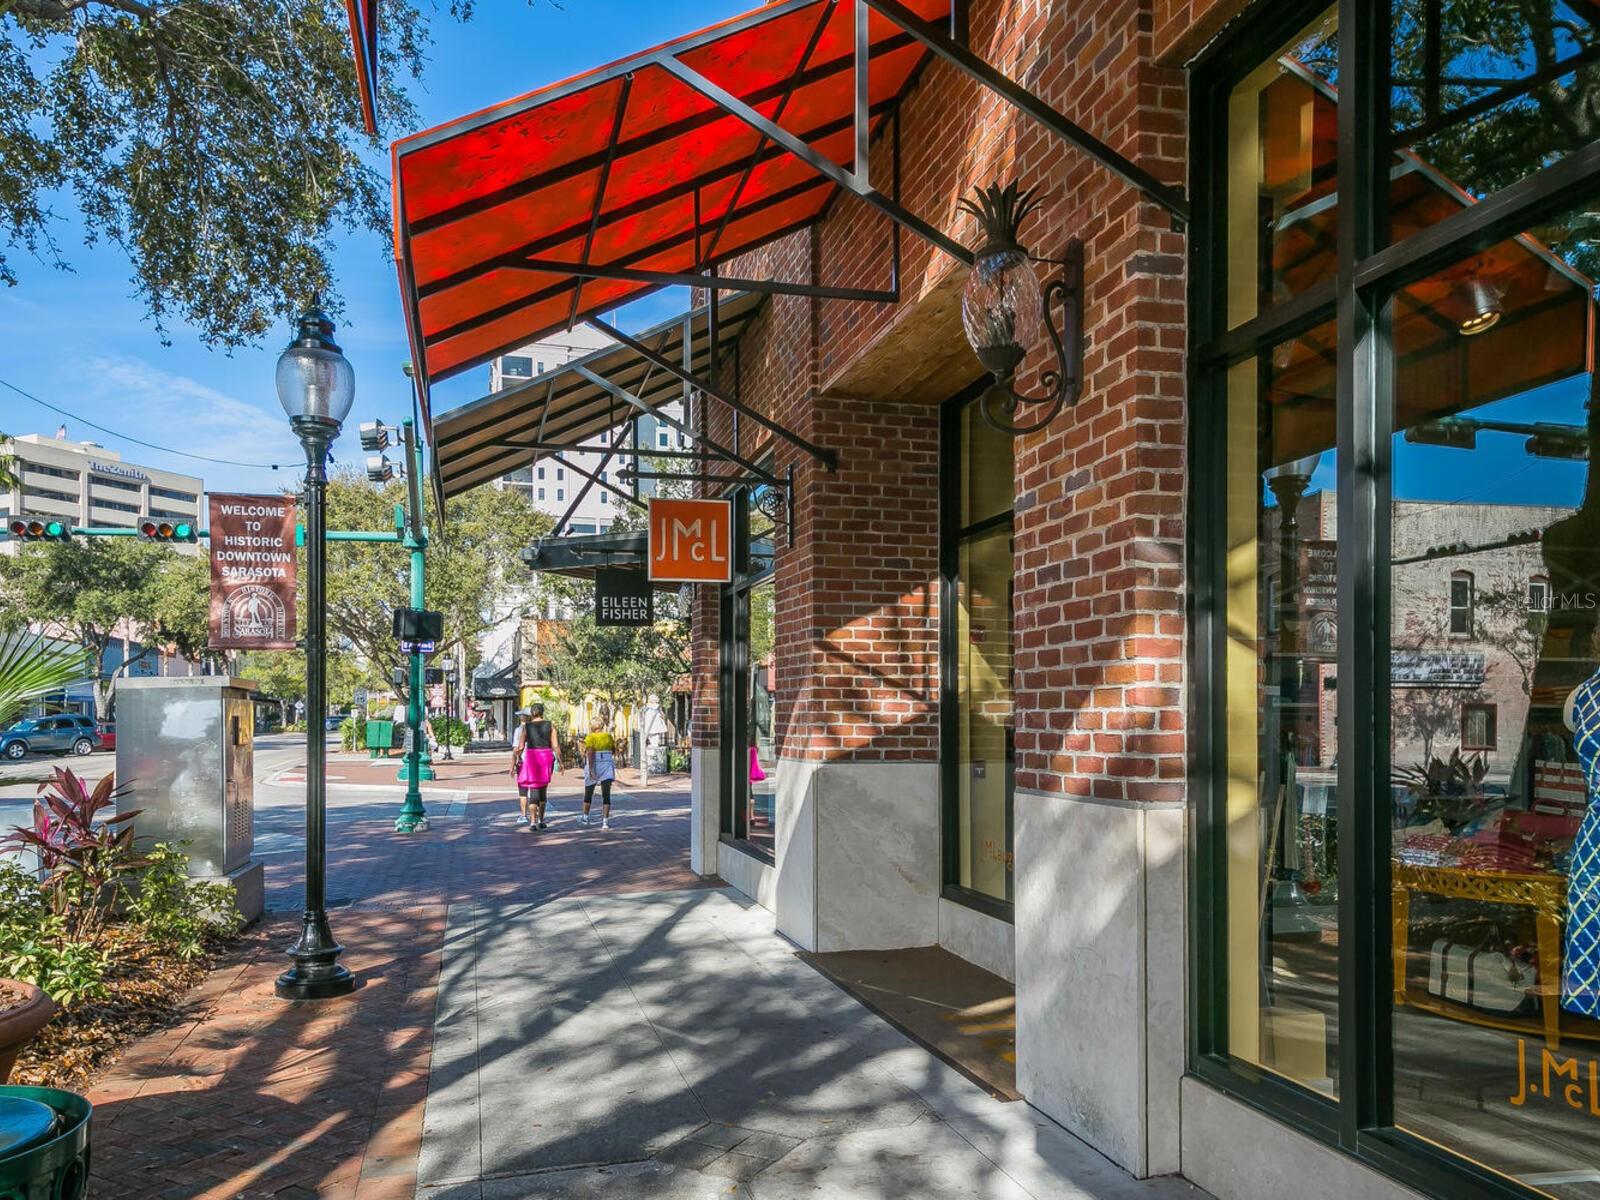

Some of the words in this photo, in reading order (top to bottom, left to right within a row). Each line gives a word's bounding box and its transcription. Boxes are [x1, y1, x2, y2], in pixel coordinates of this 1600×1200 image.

[221, 505, 285, 517] WELCOME
[245, 521, 261, 532] TO
[224, 536, 283, 547] HISTORIC
[217, 551, 291, 562] DOWNTOWN
[222, 566, 286, 578] SARASOTA
[602, 596, 648, 608] EILEEN
[602, 608, 648, 620] FISHER
